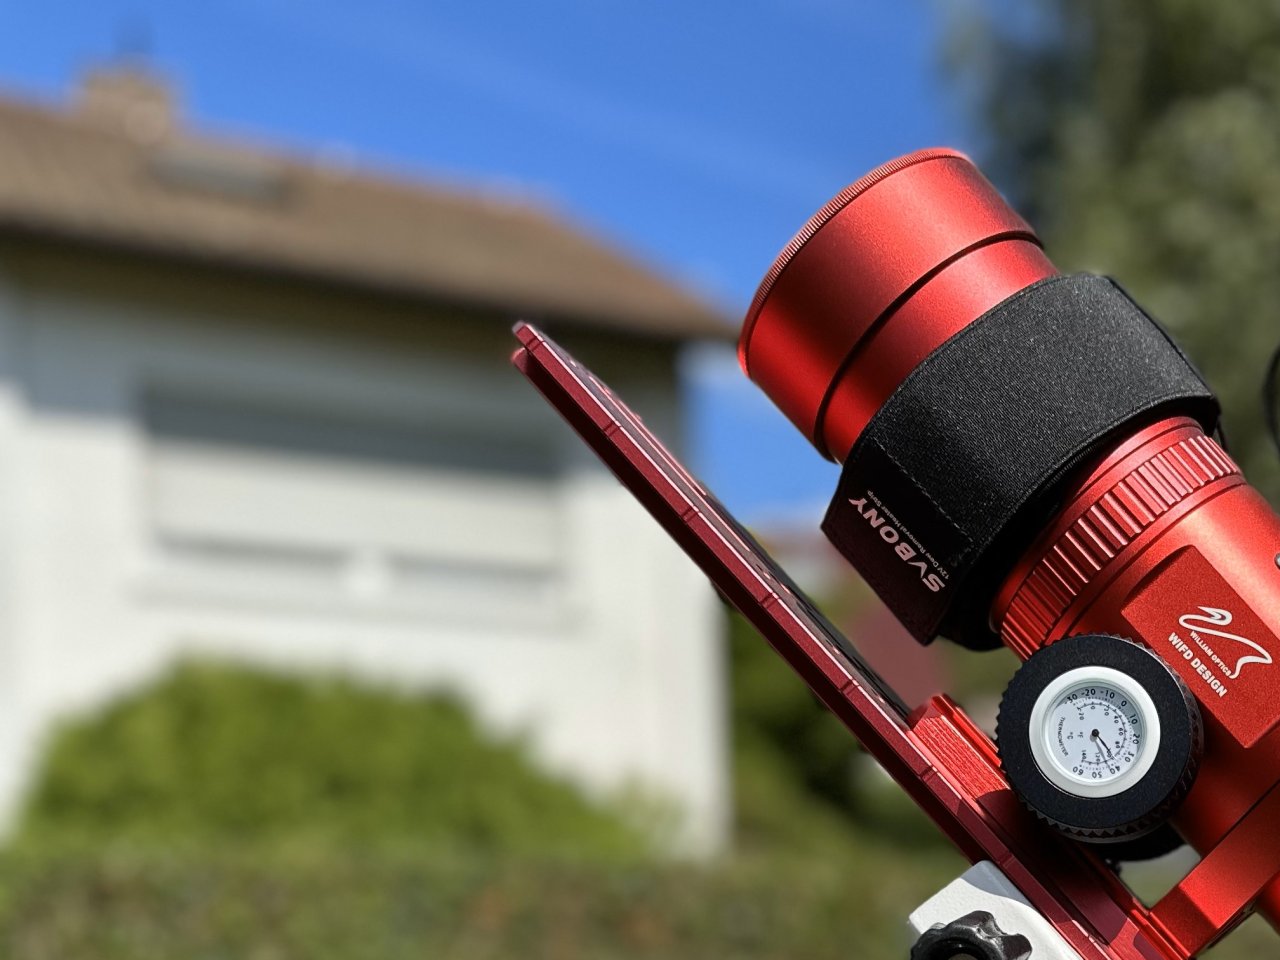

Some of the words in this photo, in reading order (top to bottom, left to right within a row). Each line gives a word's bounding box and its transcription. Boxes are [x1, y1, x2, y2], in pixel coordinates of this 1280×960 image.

[848, 498, 946, 592] SVBONY
[1168, 631, 1194, 660] WIFD
[1190, 657, 1228, 698] DESIGN
[1189, 630, 1214, 657] WILLIAM
[1211, 653, 1233, 677] OPTICS
[1081, 688, 1096, 697] -20
[1100, 689, 1115, 699] -10
[1129, 713, 1138, 725] 10
